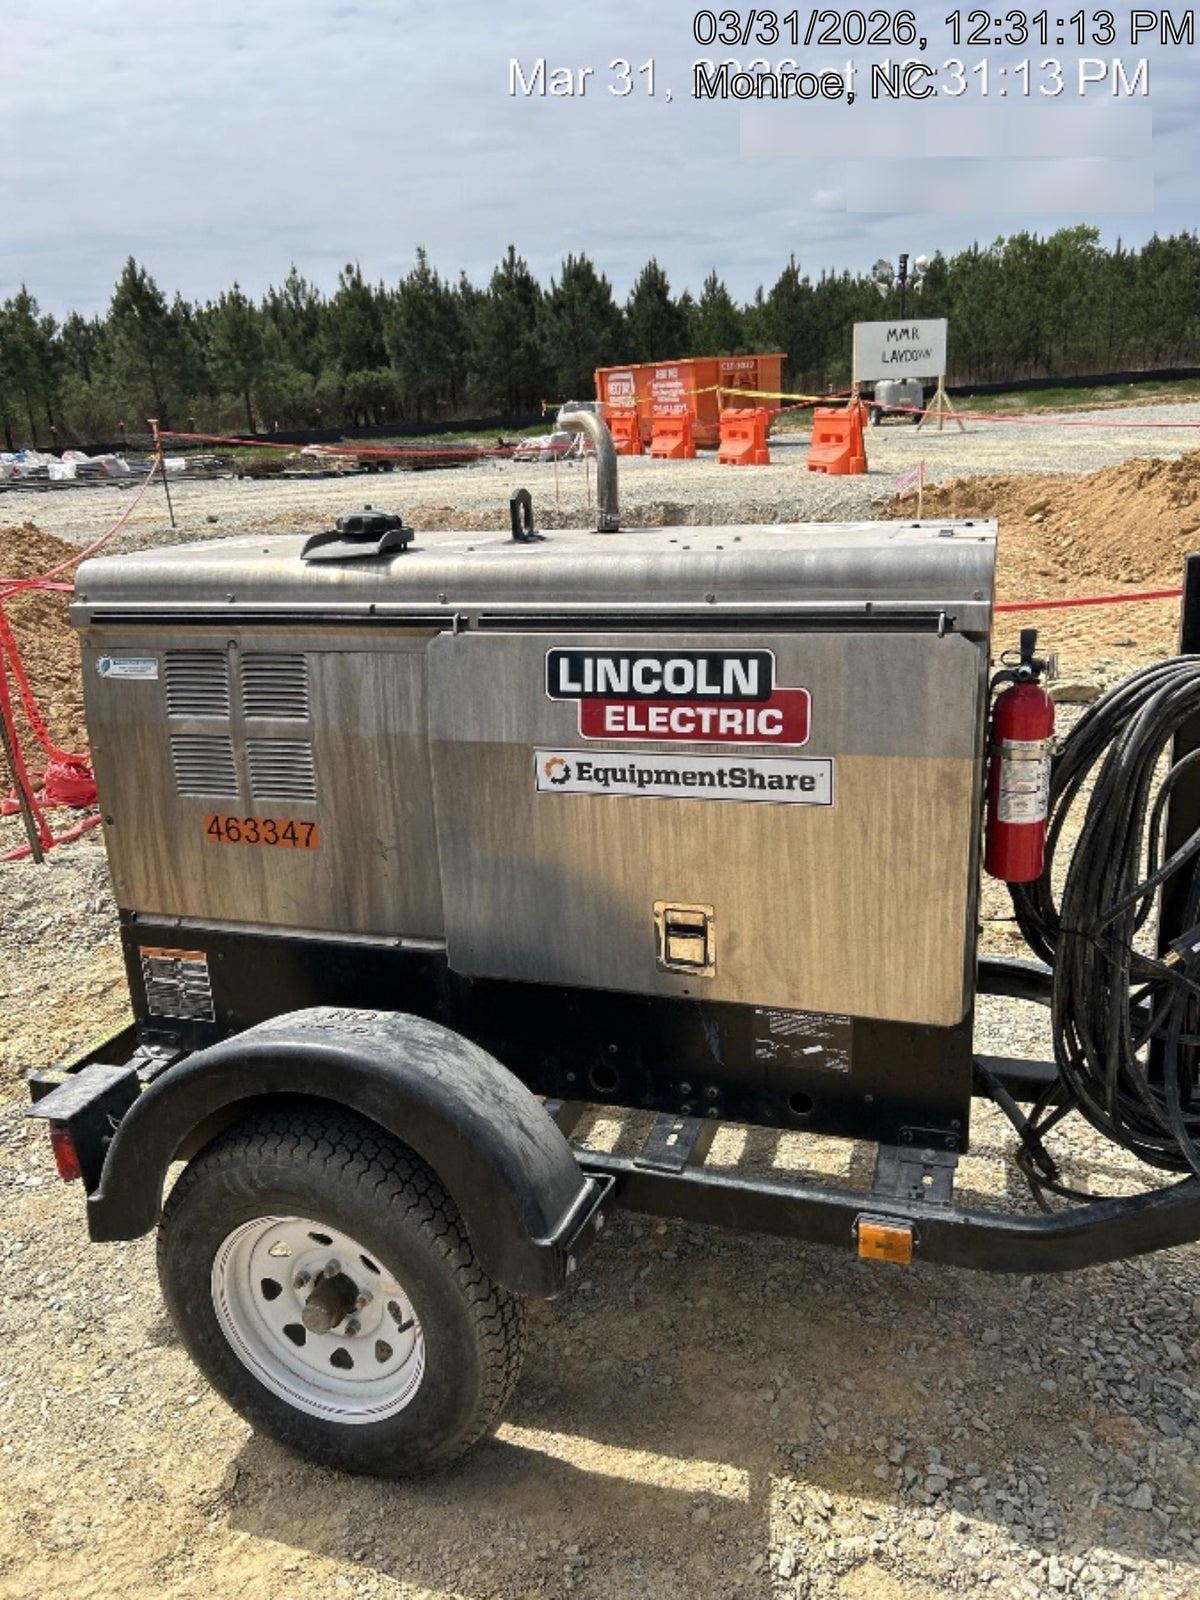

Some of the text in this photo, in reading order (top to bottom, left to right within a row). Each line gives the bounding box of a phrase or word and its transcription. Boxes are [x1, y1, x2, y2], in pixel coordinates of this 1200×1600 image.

[887, 327, 919, 342] MMR
[559, 657, 759, 696] LINCOLN
[604, 705, 784, 736] ELECTRIC
[575, 761, 816, 792] EquipmentShare
[206, 815, 316, 848] 463347
